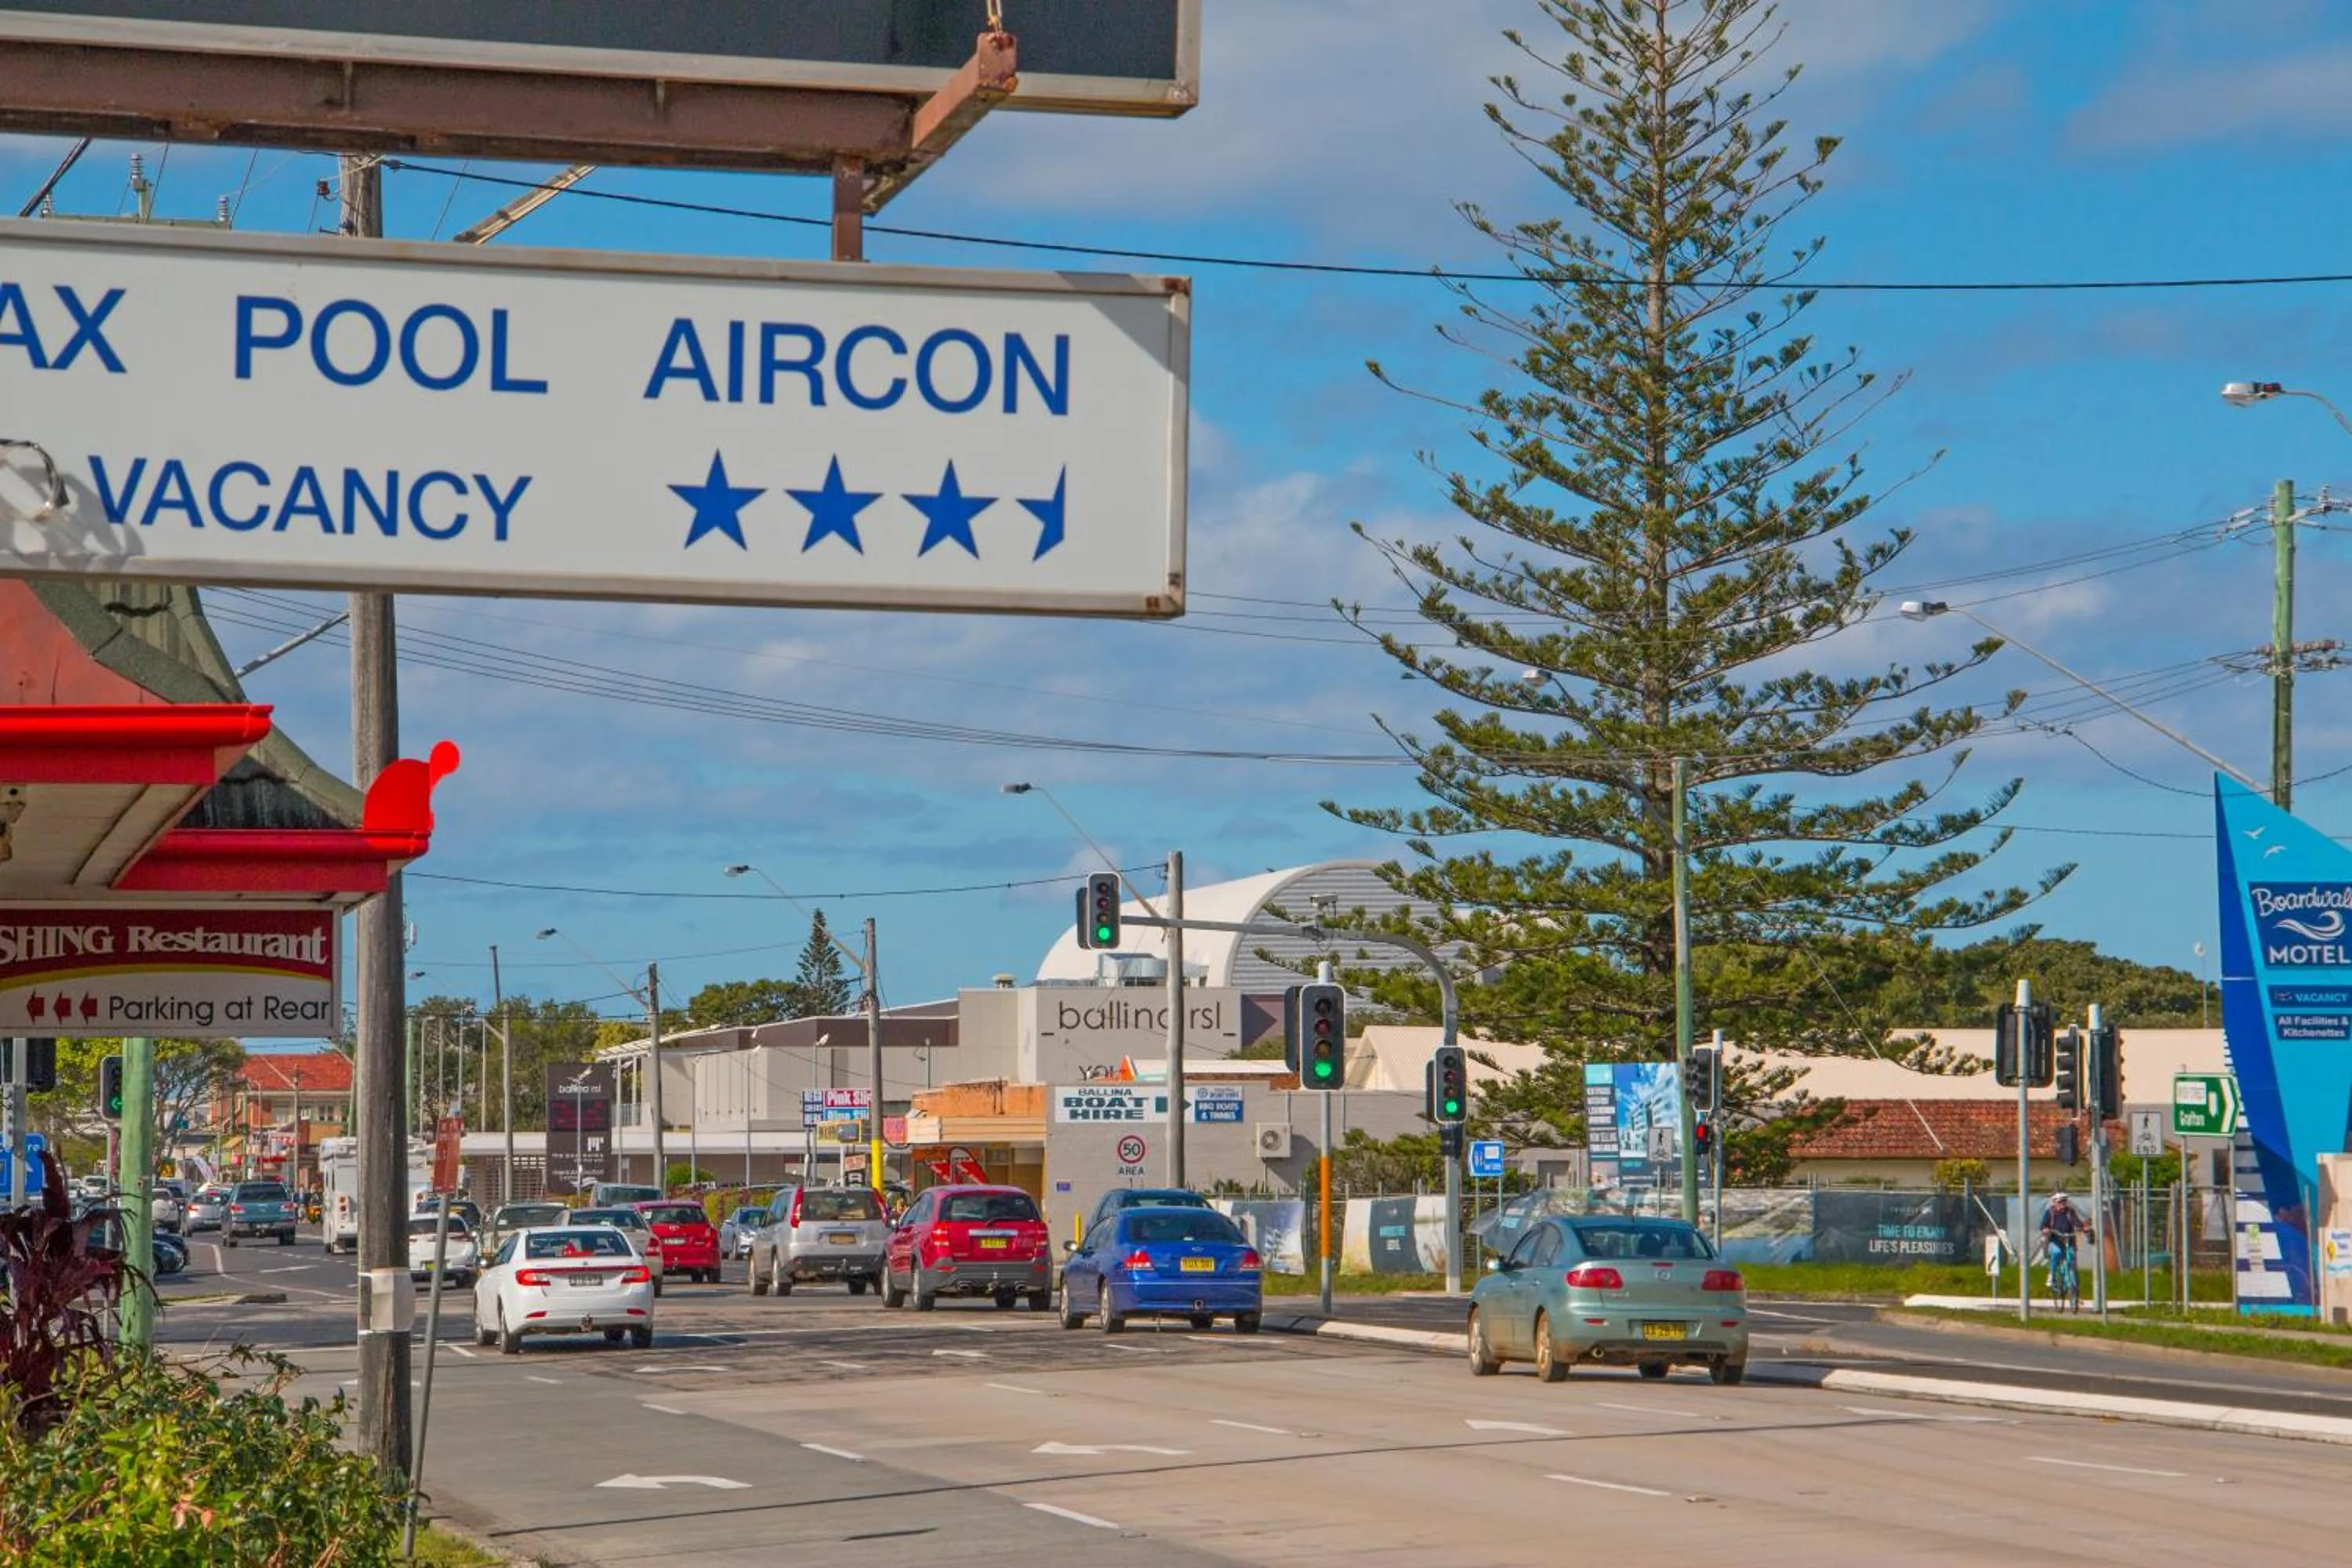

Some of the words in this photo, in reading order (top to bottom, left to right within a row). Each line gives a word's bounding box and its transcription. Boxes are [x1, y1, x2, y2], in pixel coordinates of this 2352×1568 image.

[0, 282, 127, 374] AX
[235, 295, 547, 394] POOL
[643, 318, 1069, 416] AIRCON
[88, 455, 532, 541] VACANCY
[2252, 886, 2352, 916] Boardwal
[126, 925, 328, 965] Restaurant
[2269, 945, 2351, 964] MOTEL
[2296, 993, 2349, 1003] VACANCY
[109, 995, 214, 1026] Parking
[225, 997, 254, 1020] at
[264, 996, 330, 1020] Rear
[2278, 1016, 2292, 1026] All
[2295, 1016, 2339, 1026] Facilities
[2284, 1028, 2346, 1038] Kitchenettes
[827, 1091, 851, 1105] Pink
[1078, 1088, 1133, 1097] BALLINA
[1063, 1097, 1148, 1108] BOAT
[1069, 1109, 1144, 1120] HIRE
[1123, 1143, 1142, 1156] 50
[2136, 1144, 2157, 1153] END
[1119, 1166, 1145, 1175] AREA
[1877, 1224, 1901, 1238] TIME
[1869, 1239, 1898, 1254] LIFE'S
[1900, 1240, 1955, 1254] PLEASURES
